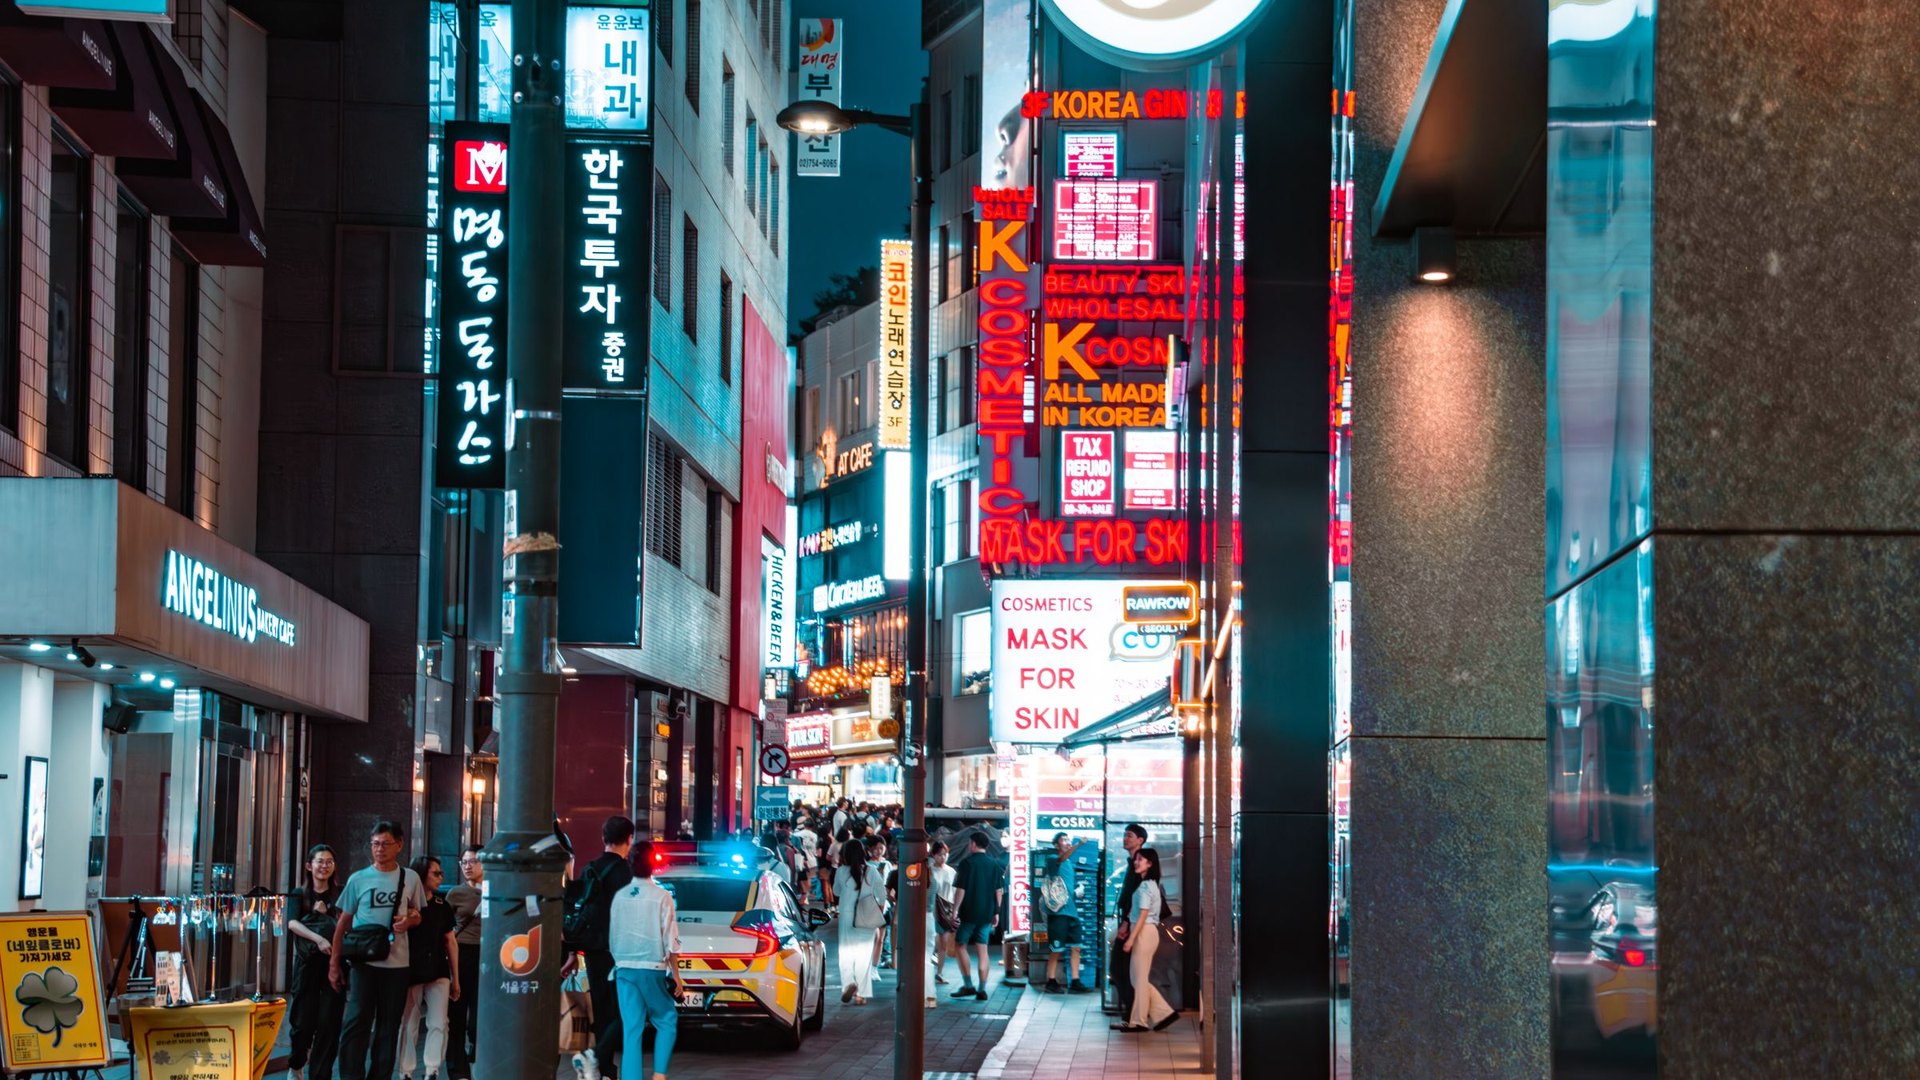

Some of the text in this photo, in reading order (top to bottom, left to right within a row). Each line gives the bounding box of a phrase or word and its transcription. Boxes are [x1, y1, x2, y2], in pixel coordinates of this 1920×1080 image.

[603, 40, 642, 119] 내과
[1053, 90, 1140, 119] KOREA
[973, 186, 1035, 203] WHOLE
[981, 203, 1028, 220] SALE
[579, 149, 625, 325] 한국투자
[979, 221, 1030, 272] K
[1044, 274, 1139, 294] BEAUTY
[601, 332, 627, 383] 증권
[1044, 322, 1100, 381] K
[1044, 382, 1093, 403] ALL
[1043, 406, 1069, 427] IN
[849, 442, 874, 472] CAFE
[1073, 437, 1103, 456] TAX
[1066, 459, 1111, 477] REFUND
[1071, 479, 1106, 497] SHOP
[979, 519, 1067, 564] MASK
[1073, 518, 1138, 565] FOR
[165, 549, 258, 643] ANGELINUS
[279, 618, 295, 647] CAFE
[1001, 597, 1093, 612] COSMETICS
[1126, 596, 1190, 611] RAWROW
[1007, 628, 1088, 650] MASK
[1020, 668, 1075, 689] FOR
[1015, 708, 1079, 730] SKIN
[1051, 816, 1095, 829] COSRX
[1013, 804, 1029, 908] COSMETICS
[500, 980, 540, 994] 서울중구
